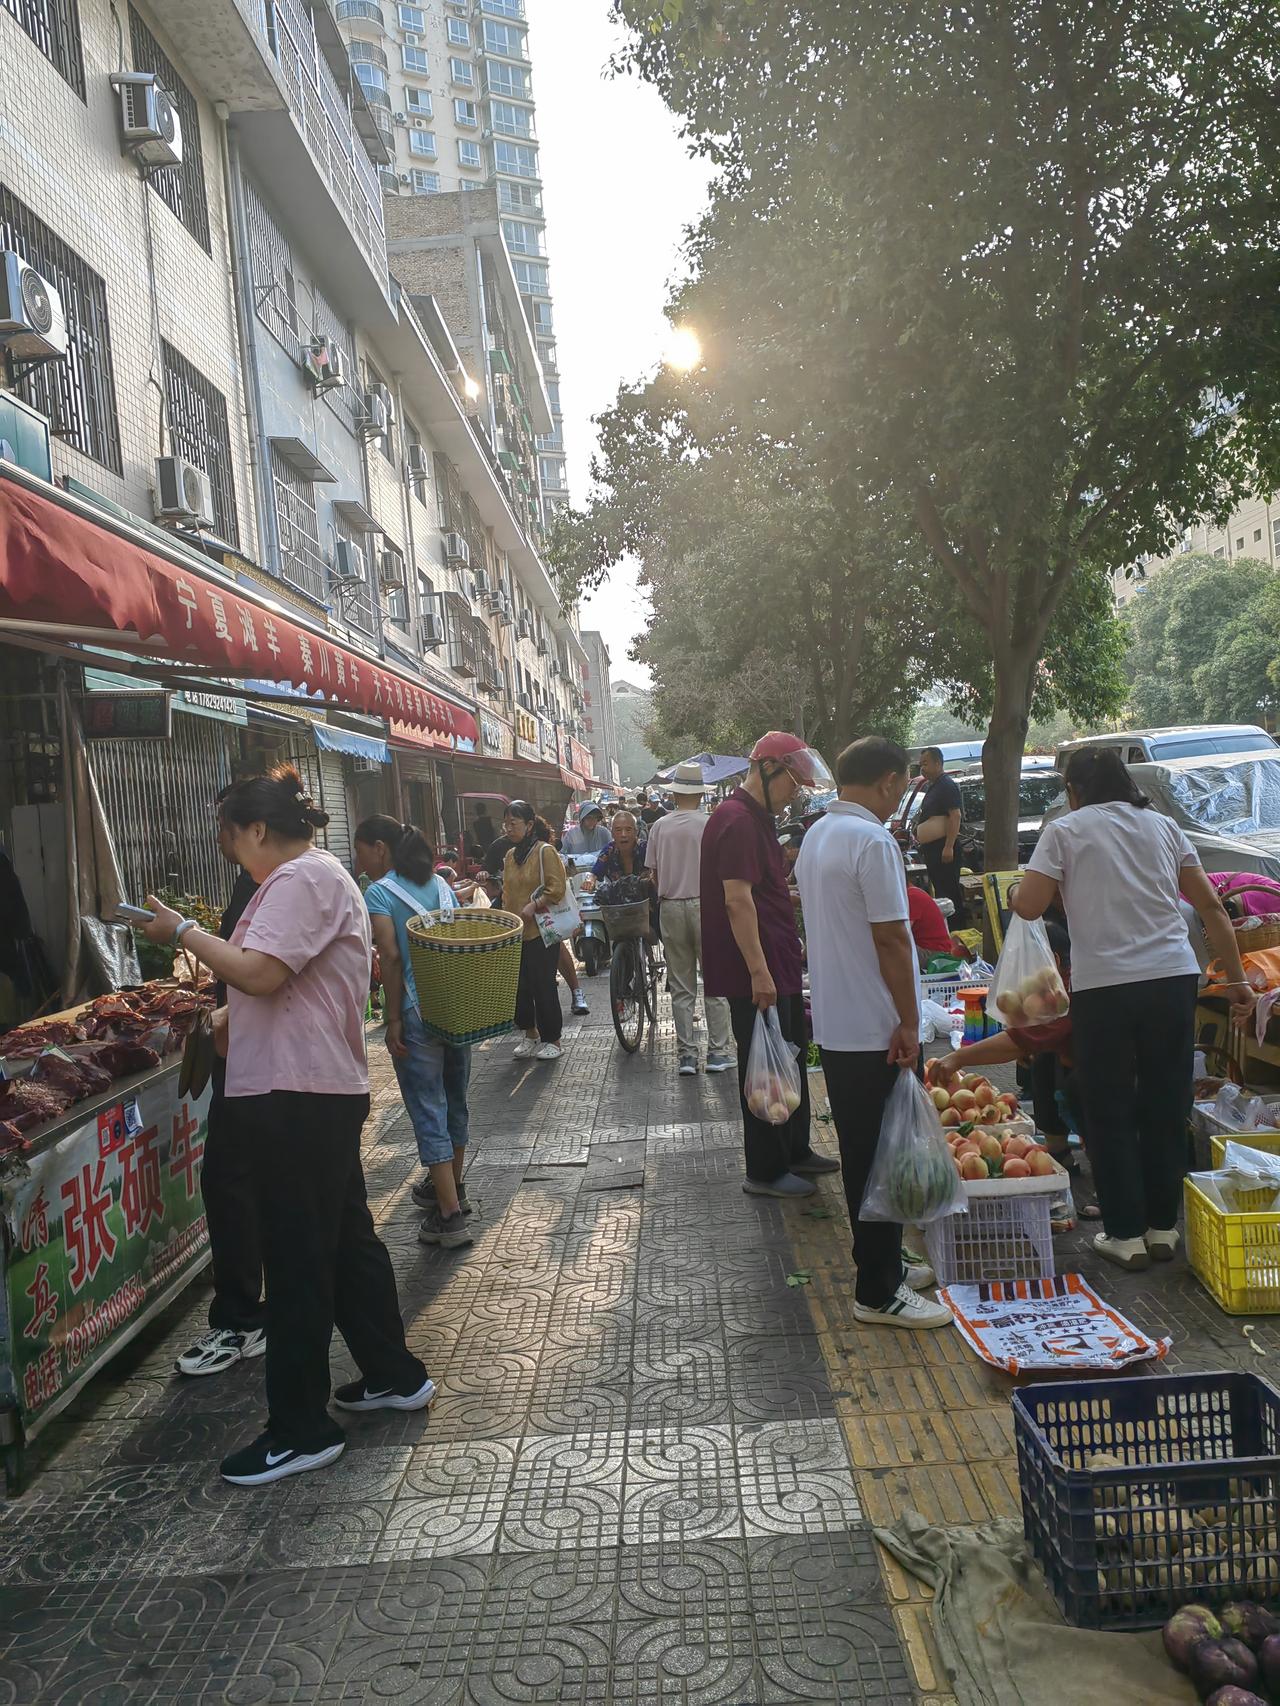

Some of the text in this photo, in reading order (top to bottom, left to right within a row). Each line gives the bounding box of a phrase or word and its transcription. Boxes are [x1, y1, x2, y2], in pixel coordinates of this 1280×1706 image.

[176, 577, 281, 661] 宁夏滩羊
[298, 633, 360, 693] 秦川黄牛
[21, 1185, 59, 1339] 清真
[60, 1102, 205, 1294] 张硕牛
